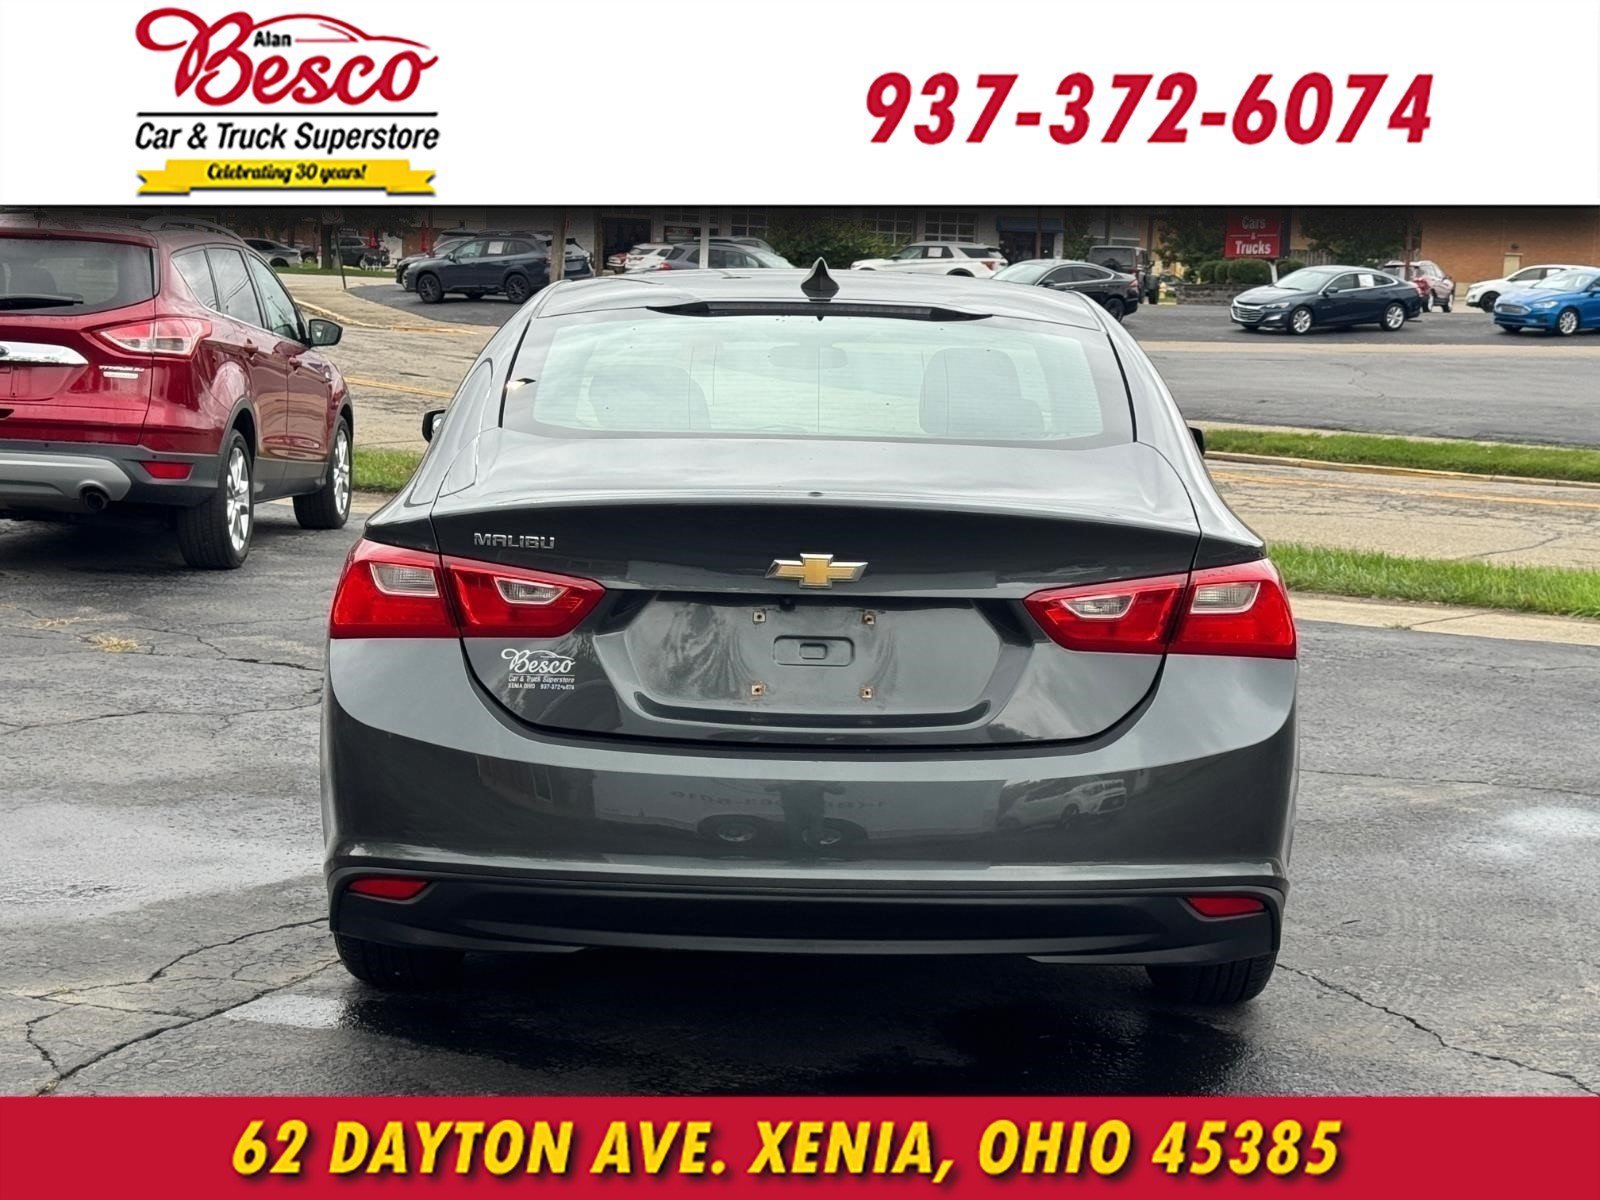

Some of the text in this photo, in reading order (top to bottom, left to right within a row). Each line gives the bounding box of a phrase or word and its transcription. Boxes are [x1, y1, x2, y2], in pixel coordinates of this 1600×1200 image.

[1242, 216, 1266, 229] Cars
[1235, 240, 1272, 255] Trucks
[473, 532, 556, 549] MALIBU
[501, 648, 576, 673] Besco
[508, 674, 519, 682] Car
[526, 675, 541, 683] Truck
[542, 676, 575, 684] Superstore
